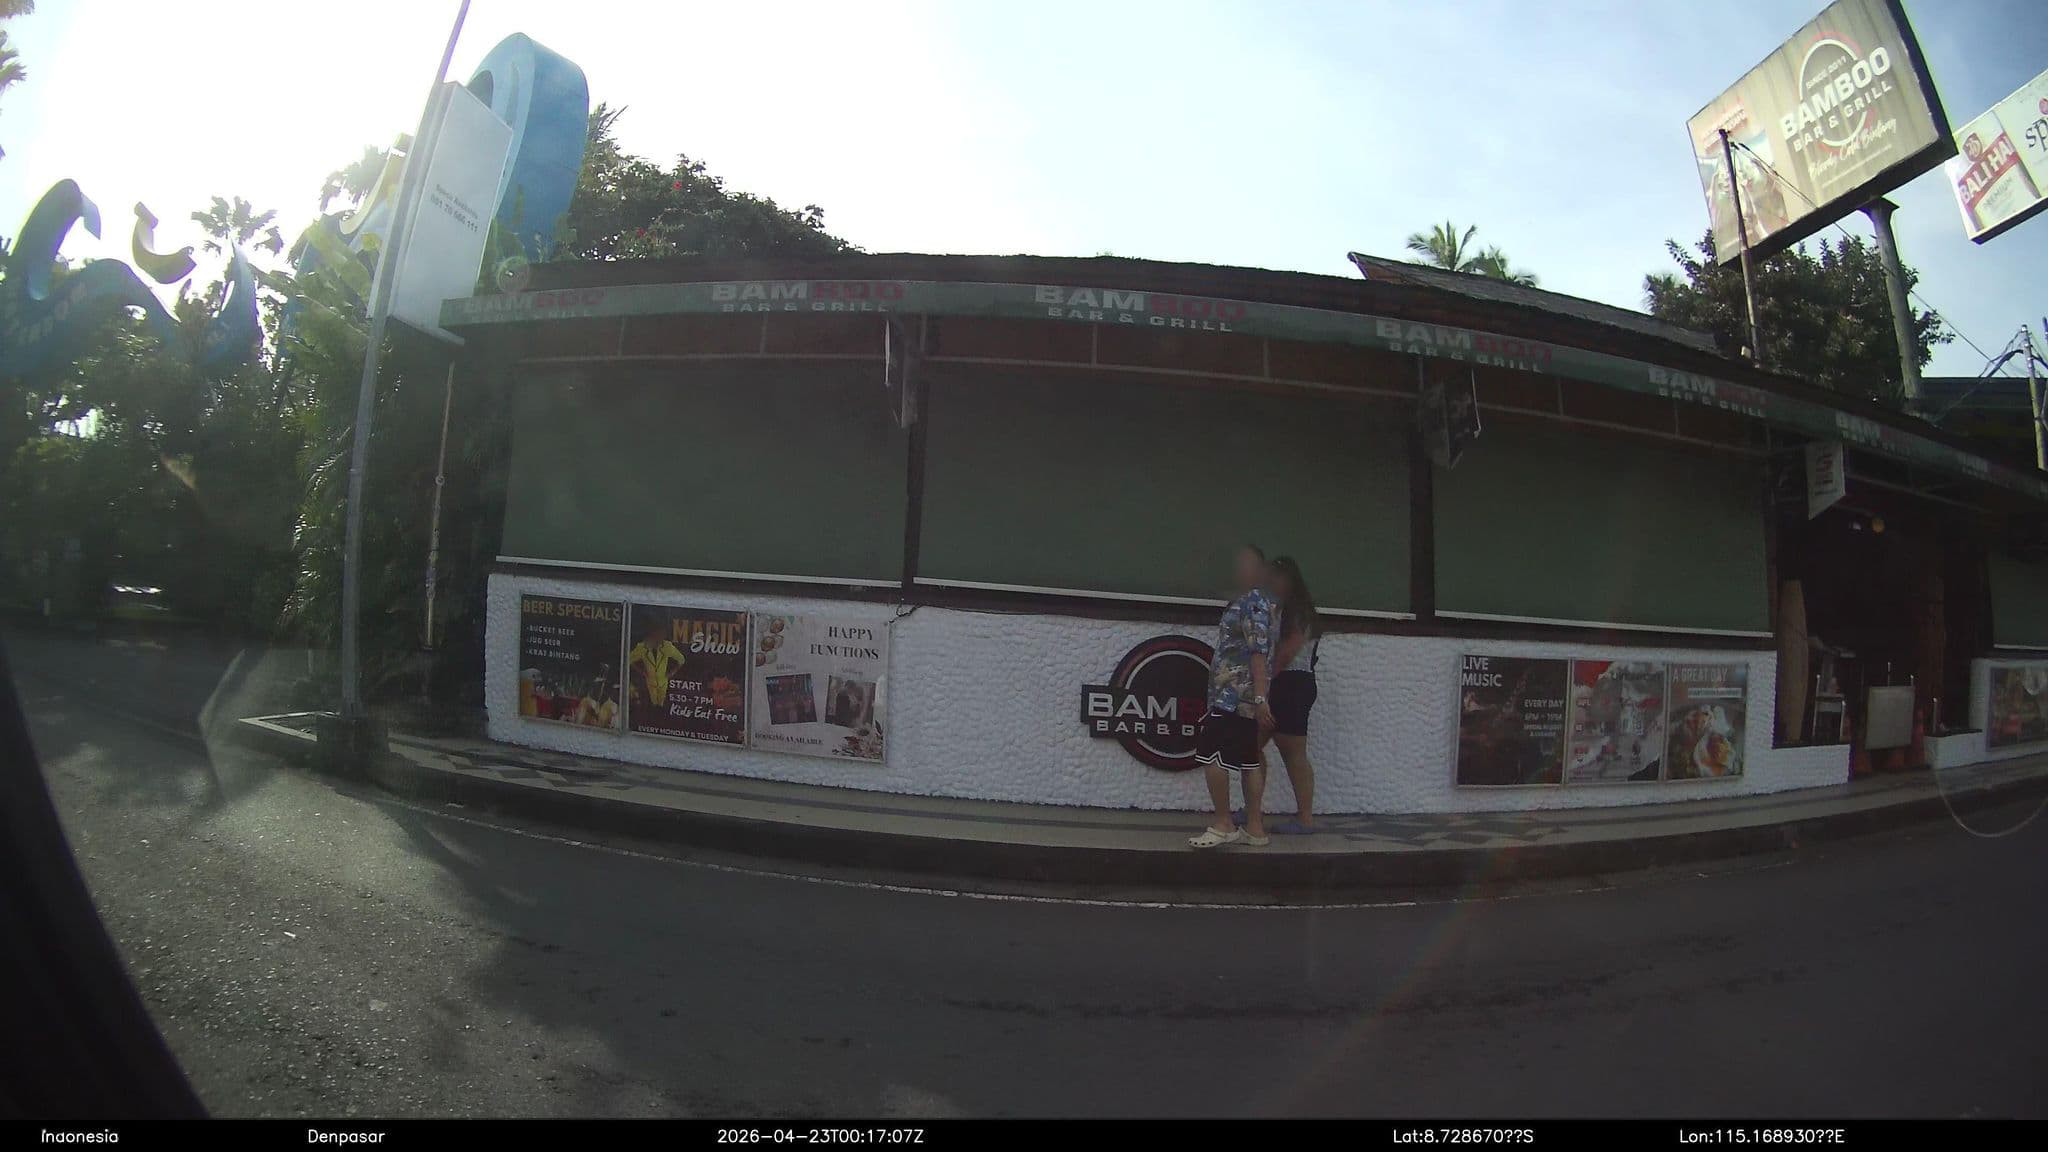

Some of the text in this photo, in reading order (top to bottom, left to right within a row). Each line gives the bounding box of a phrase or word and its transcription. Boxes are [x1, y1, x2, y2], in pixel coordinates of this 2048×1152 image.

[1780, 46, 1891, 140] BAMBOO
[1793, 80, 1893, 152] BAR & GRILL
[1959, 161, 1993, 205] BALI
[713, 281, 903, 301] BAMBOO
[722, 302, 890, 313] BAR & GRILL
[1035, 286, 1244, 320] BAMBOO
[1048, 306, 1232, 332] BAR & GRILL
[1376, 320, 1553, 362] BAMBOO
[1390, 342, 1438, 357] BAR
[1476, 353, 1544, 374] GRILL
[523, 600, 620, 622] BEER SPECIALS
[672, 618, 740, 645] MAGIC
[829, 625, 873, 641] HAPPY
[690, 631, 740, 654] Show
[810, 643, 880, 660] FUNCTIONS
[1463, 656, 1489, 670] LIVE
[1462, 672, 1503, 687] MUSIC
[1672, 667, 1679, 681] A
[1681, 667, 1708, 681] GREAT
[669, 680, 702, 690] START
[670, 703, 738, 723] Kids Eat Free
[1524, 699, 1565, 708] EVERY DAY
[638, 725, 659, 733] EVERY
[660, 729, 690, 737] MONDAY
[696, 732, 729, 742] TUESDAY
[1096, 720, 1145, 733] BAR
[1157, 724, 1170, 735] &
